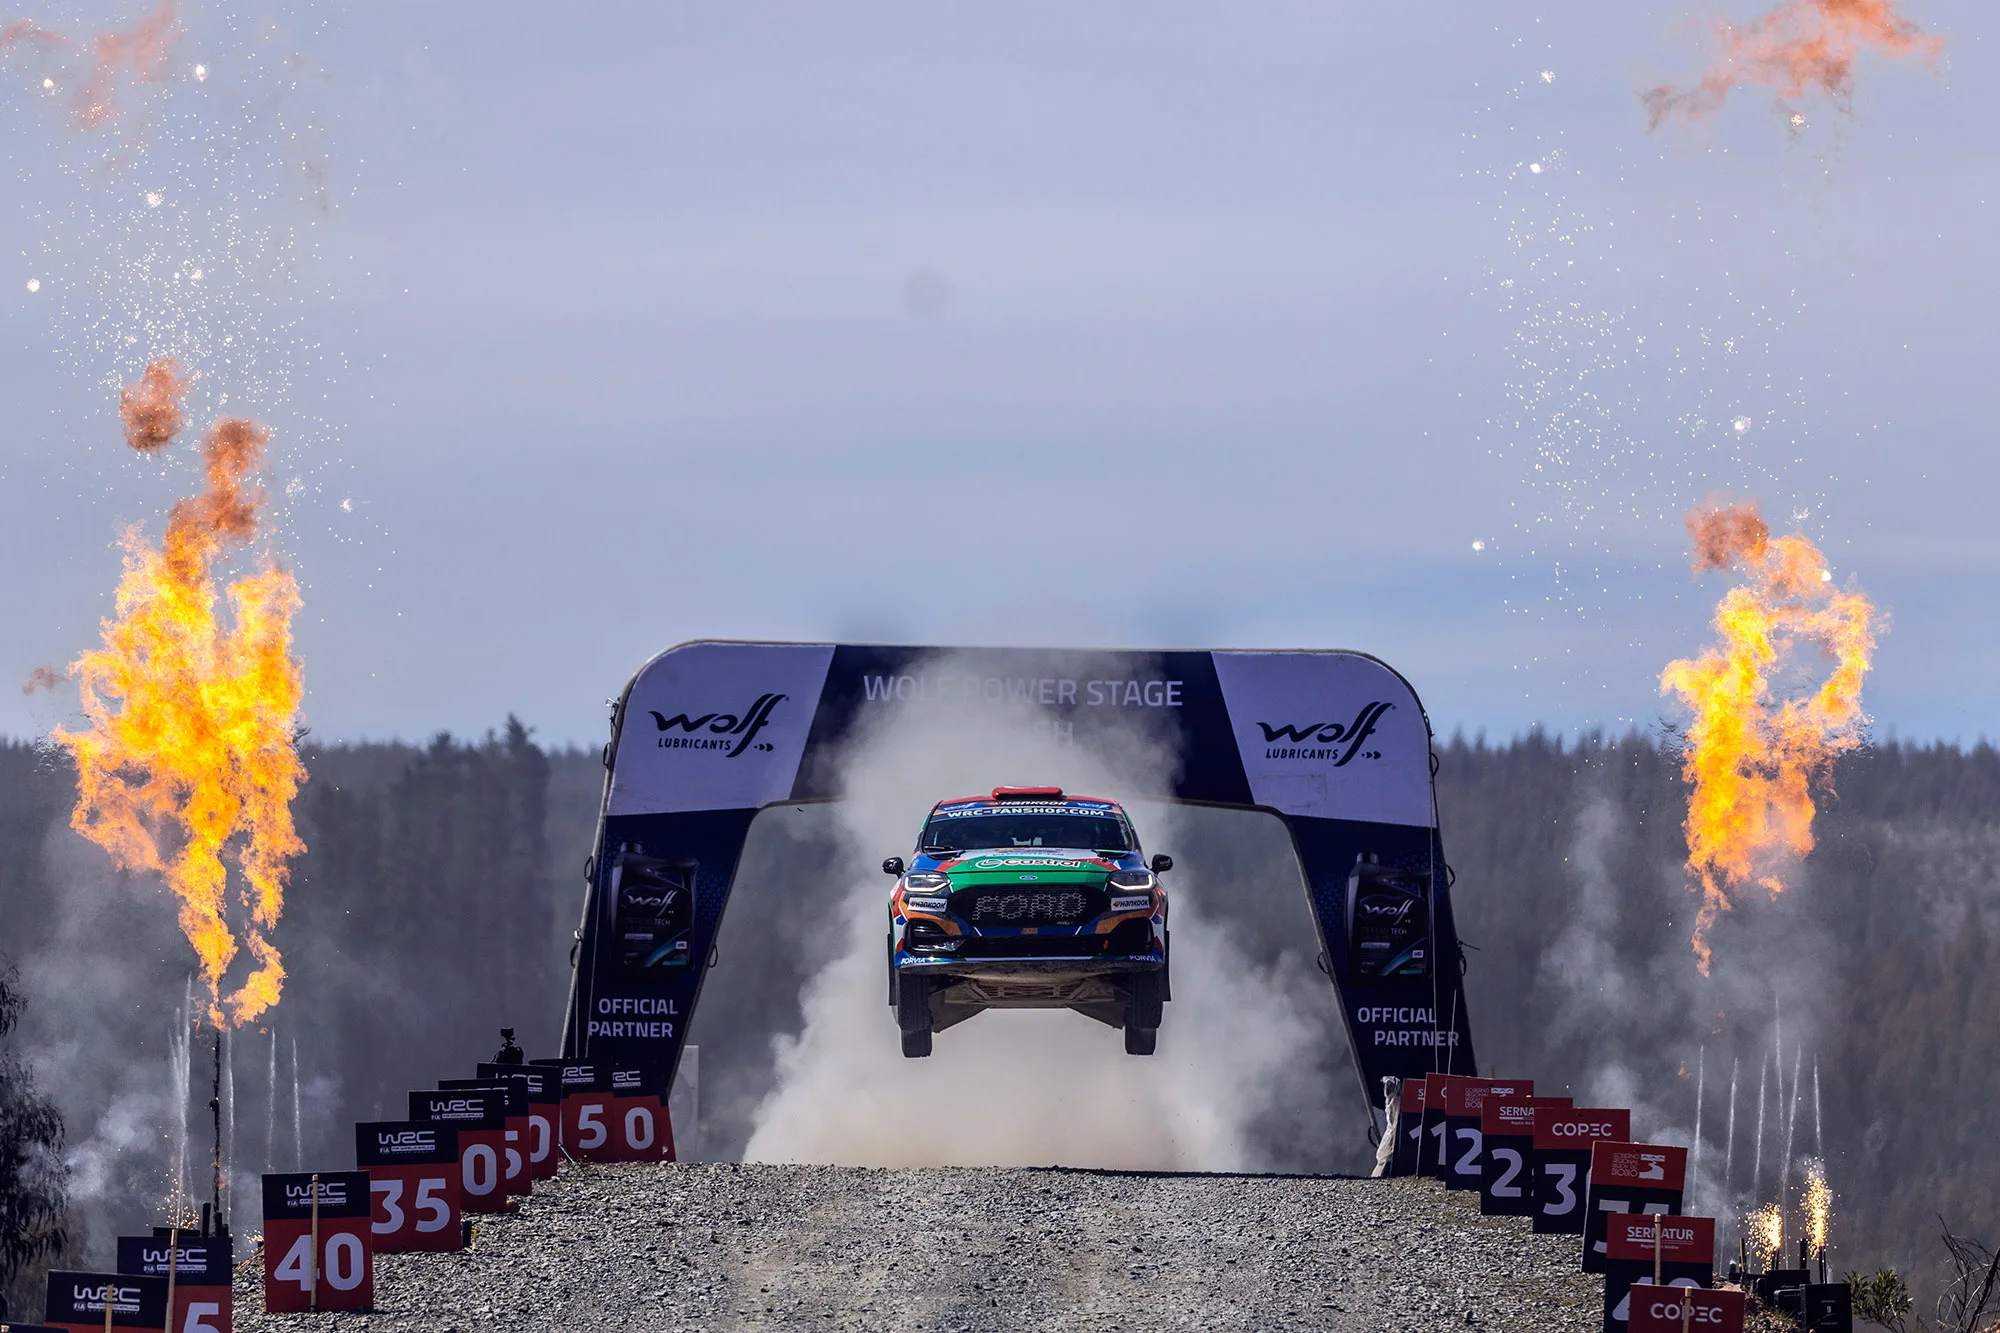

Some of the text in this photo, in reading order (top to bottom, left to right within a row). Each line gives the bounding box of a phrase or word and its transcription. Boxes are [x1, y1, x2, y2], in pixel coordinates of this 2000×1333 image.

[964, 676, 1076, 706] POWER
[1086, 680, 1183, 707] STAGE
[648, 693, 788, 758] wolf
[1256, 701, 1393, 767] wolf
[658, 738, 731, 752] LUBRICANTS
[1266, 748, 1339, 760] LUBRICANTS
[947, 807, 1105, 818] WRC-FANSHOP.COM
[1003, 858, 1081, 869] Castrol
[654, 918, 671, 927] TECH
[1391, 927, 1408, 936] TECH
[598, 998, 679, 1015] OFFICIAL
[1357, 1006, 1437, 1024] OFFICIAL
[588, 1020, 674, 1038] PARTNER
[1374, 1029, 1460, 1047] PARTNER
[562, 1065, 595, 1078] RC
[612, 1070, 642, 1083] RC
[430, 1098, 484, 1113] WRC
[578, 1104, 608, 1150] 5
[624, 1106, 655, 1150] 0
[1552, 1122, 1612, 1138] COPEC
[378, 1130, 435, 1145] WRC
[462, 1143, 497, 1196] 0
[1490, 1148, 1534, 1198] 2
[286, 1182, 346, 1198] WRC
[1542, 1163, 1591, 1216] 3
[370, 1177, 451, 1235] 35
[143, 1248, 208, 1263] WRC
[273, 1232, 365, 1292] 40
[73, 1284, 141, 1304] WRC
[167, 1302, 219, 1333] 5
